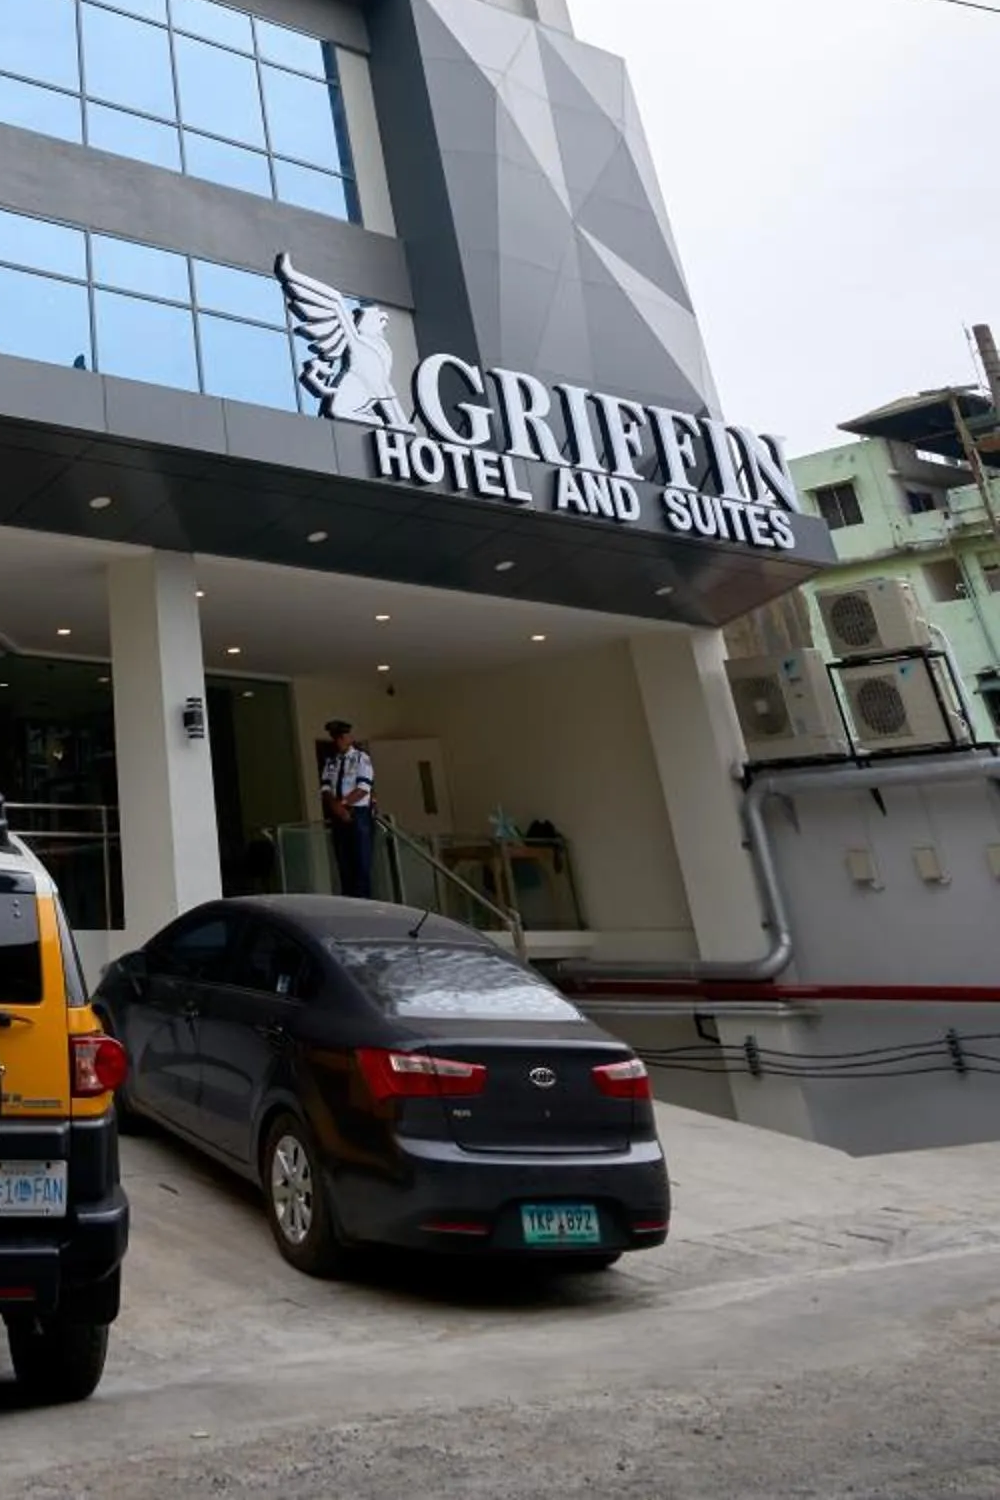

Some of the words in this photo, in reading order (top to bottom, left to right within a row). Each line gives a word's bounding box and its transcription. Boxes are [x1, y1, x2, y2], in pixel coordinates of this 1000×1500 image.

[373, 429, 532, 503] HOTEL
[555, 467, 641, 522] AND
[663, 489, 796, 550] SUITES
[412, 352, 801, 513] GRIFFIN
[33, 1177, 64, 1204] FAN
